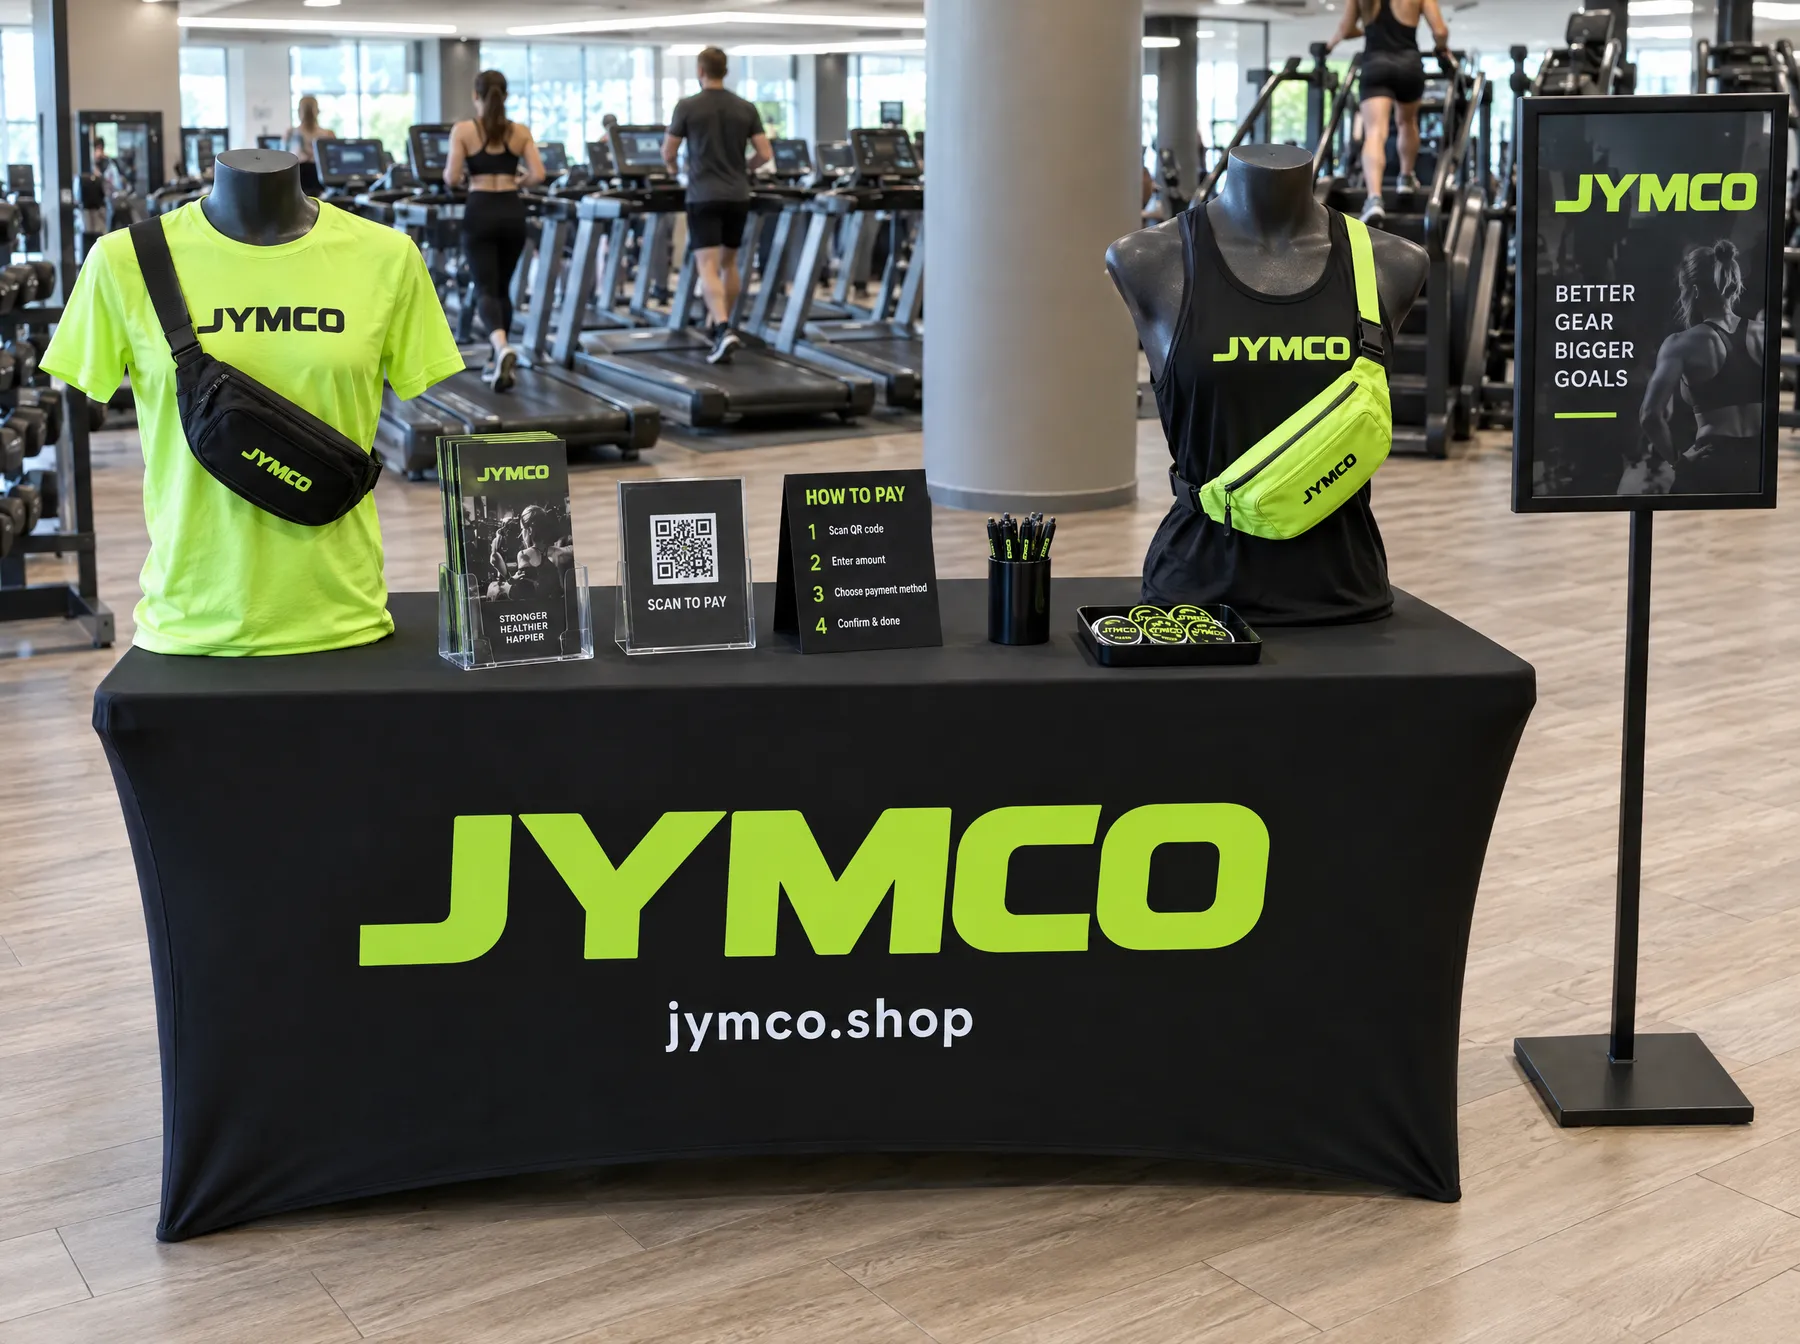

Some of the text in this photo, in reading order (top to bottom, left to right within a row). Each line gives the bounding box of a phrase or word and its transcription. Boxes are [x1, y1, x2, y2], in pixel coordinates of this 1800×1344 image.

[1554, 172, 1757, 214] JYMCO
[1555, 284, 1635, 303] BETTER
[197, 306, 345, 335] JYMCO
[1555, 313, 1614, 331] GEAR
[1212, 335, 1351, 362] JYMCO
[1555, 341, 1634, 359] BIGGER
[1554, 369, 1628, 388] GOALS
[241, 448, 312, 492] JYMCO
[476, 464, 550, 482] JYMCO
[1302, 452, 1357, 506] JYMCO
[805, 485, 906, 505] HOW TO PAY
[808, 522, 884, 539] 1 Scan QR code
[810, 554, 887, 571] 2 Enter amount
[813, 582, 928, 602] 3 Choose payment method
[647, 595, 727, 611] SCAN TO PAY
[499, 611, 548, 624] STRONGER
[815, 616, 901, 634] 4 Confirm & done
[500, 621, 548, 634] HEALTHIER
[506, 632, 545, 645] HAPPIER
[358, 801, 1271, 967] JYMCO
[665, 997, 973, 1053] jymco.shop
